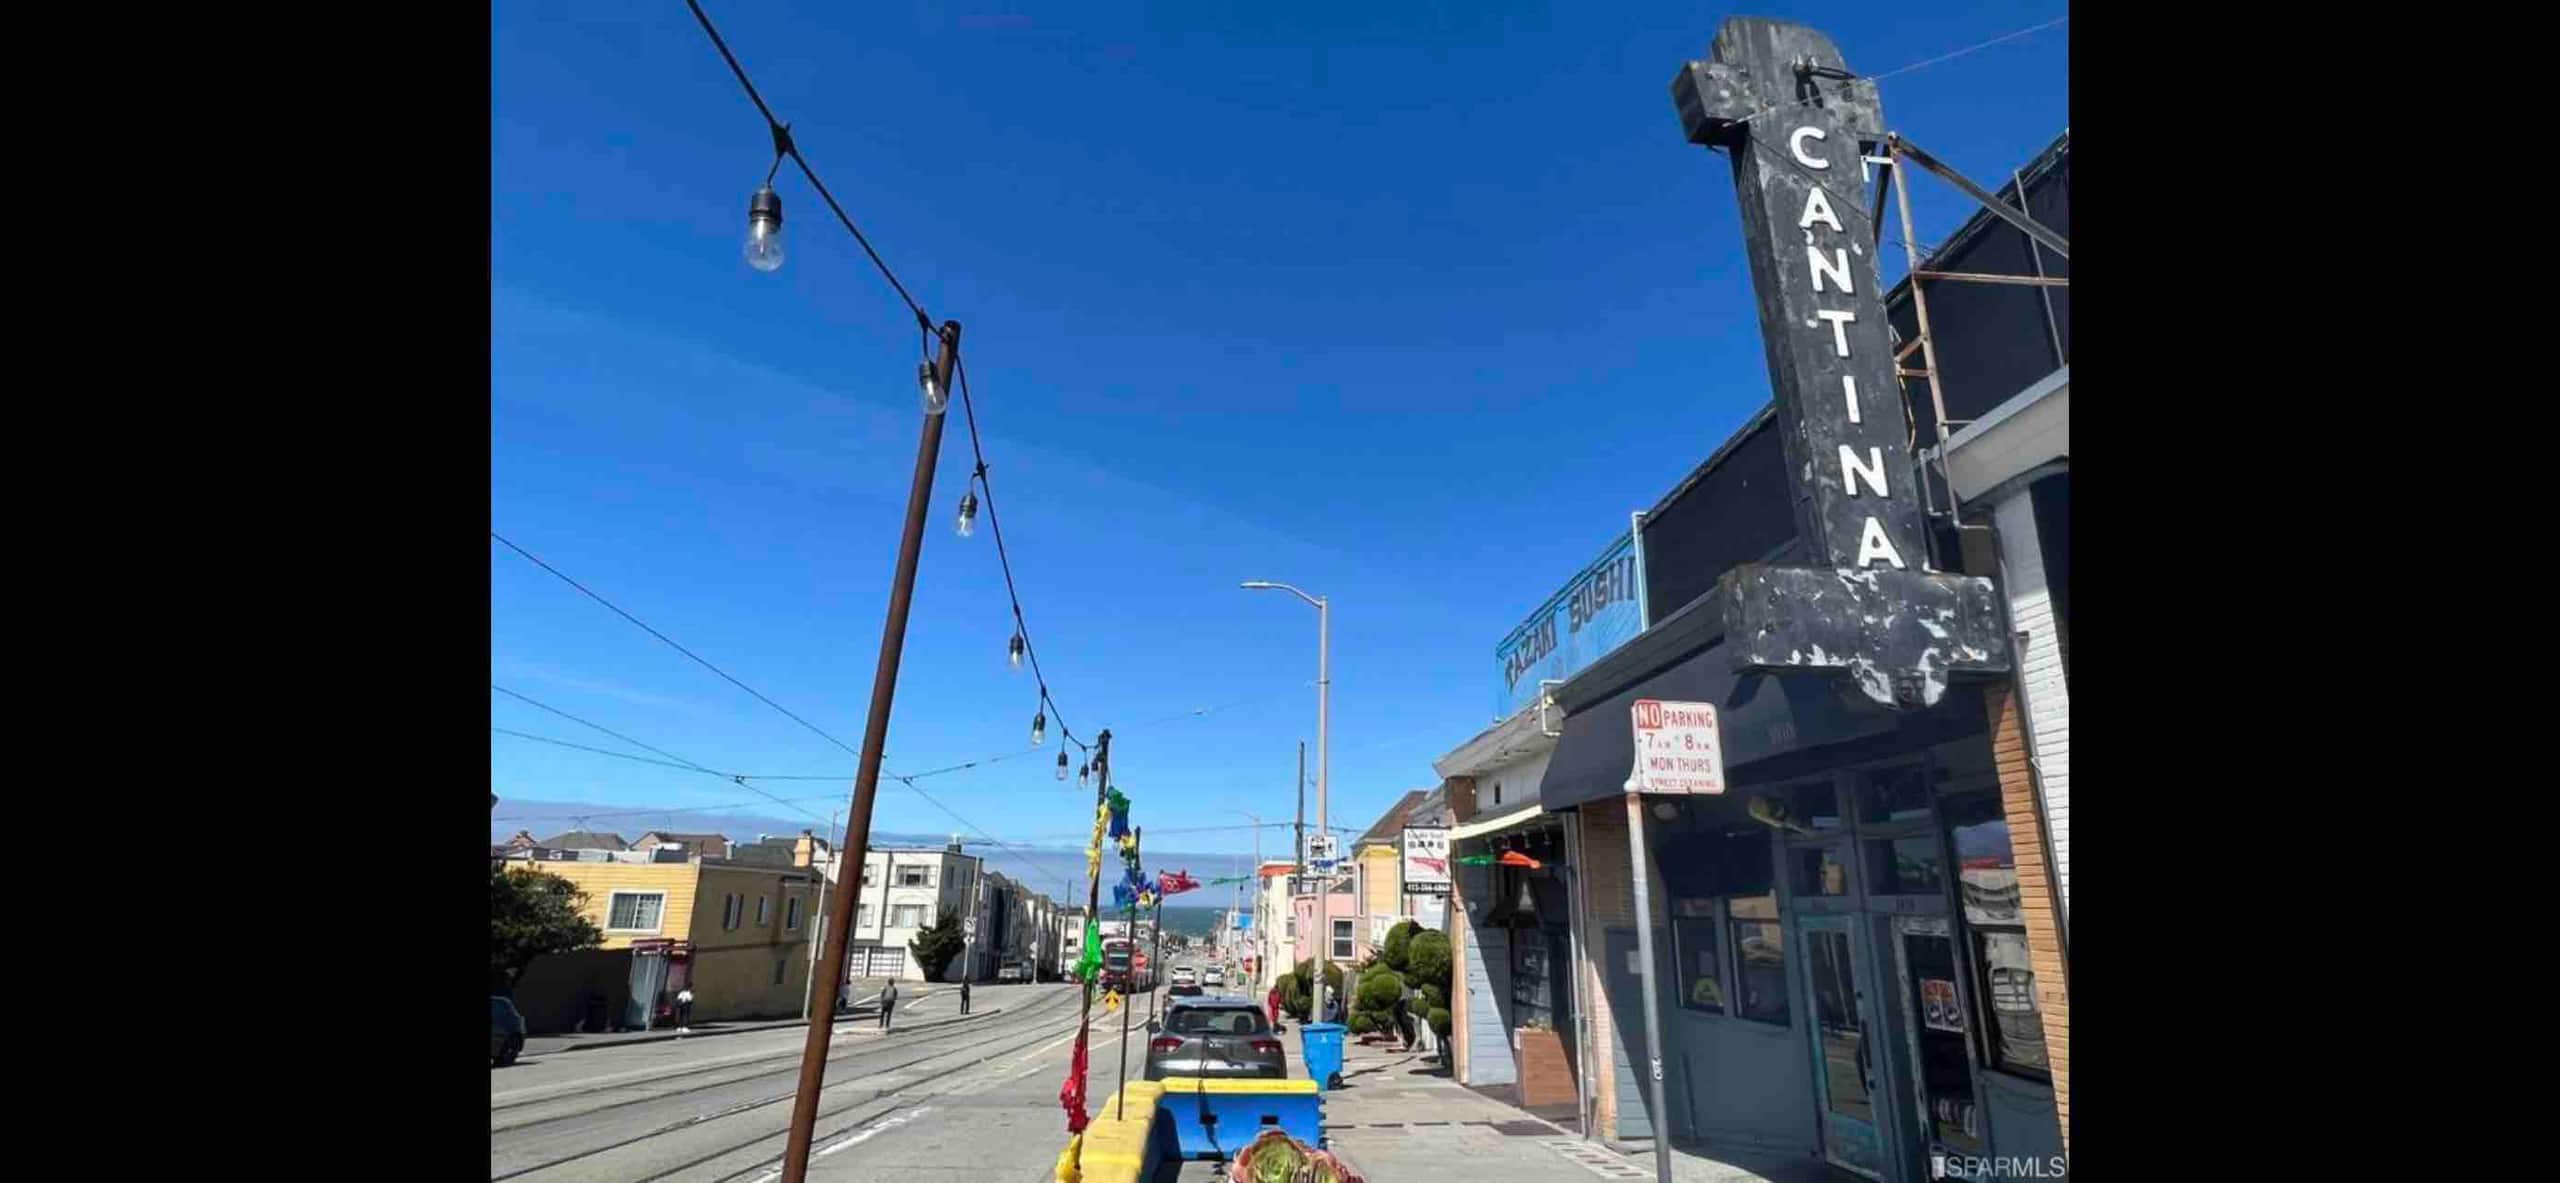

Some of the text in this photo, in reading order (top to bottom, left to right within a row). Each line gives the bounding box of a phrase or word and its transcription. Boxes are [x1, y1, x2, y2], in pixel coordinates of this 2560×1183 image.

[1789, 125, 1907, 570] CANTINA
[1569, 555, 1636, 634] SUSHI
[1637, 703, 1713, 729] NO PARKING
[1650, 757, 1711, 773] MON THURS
